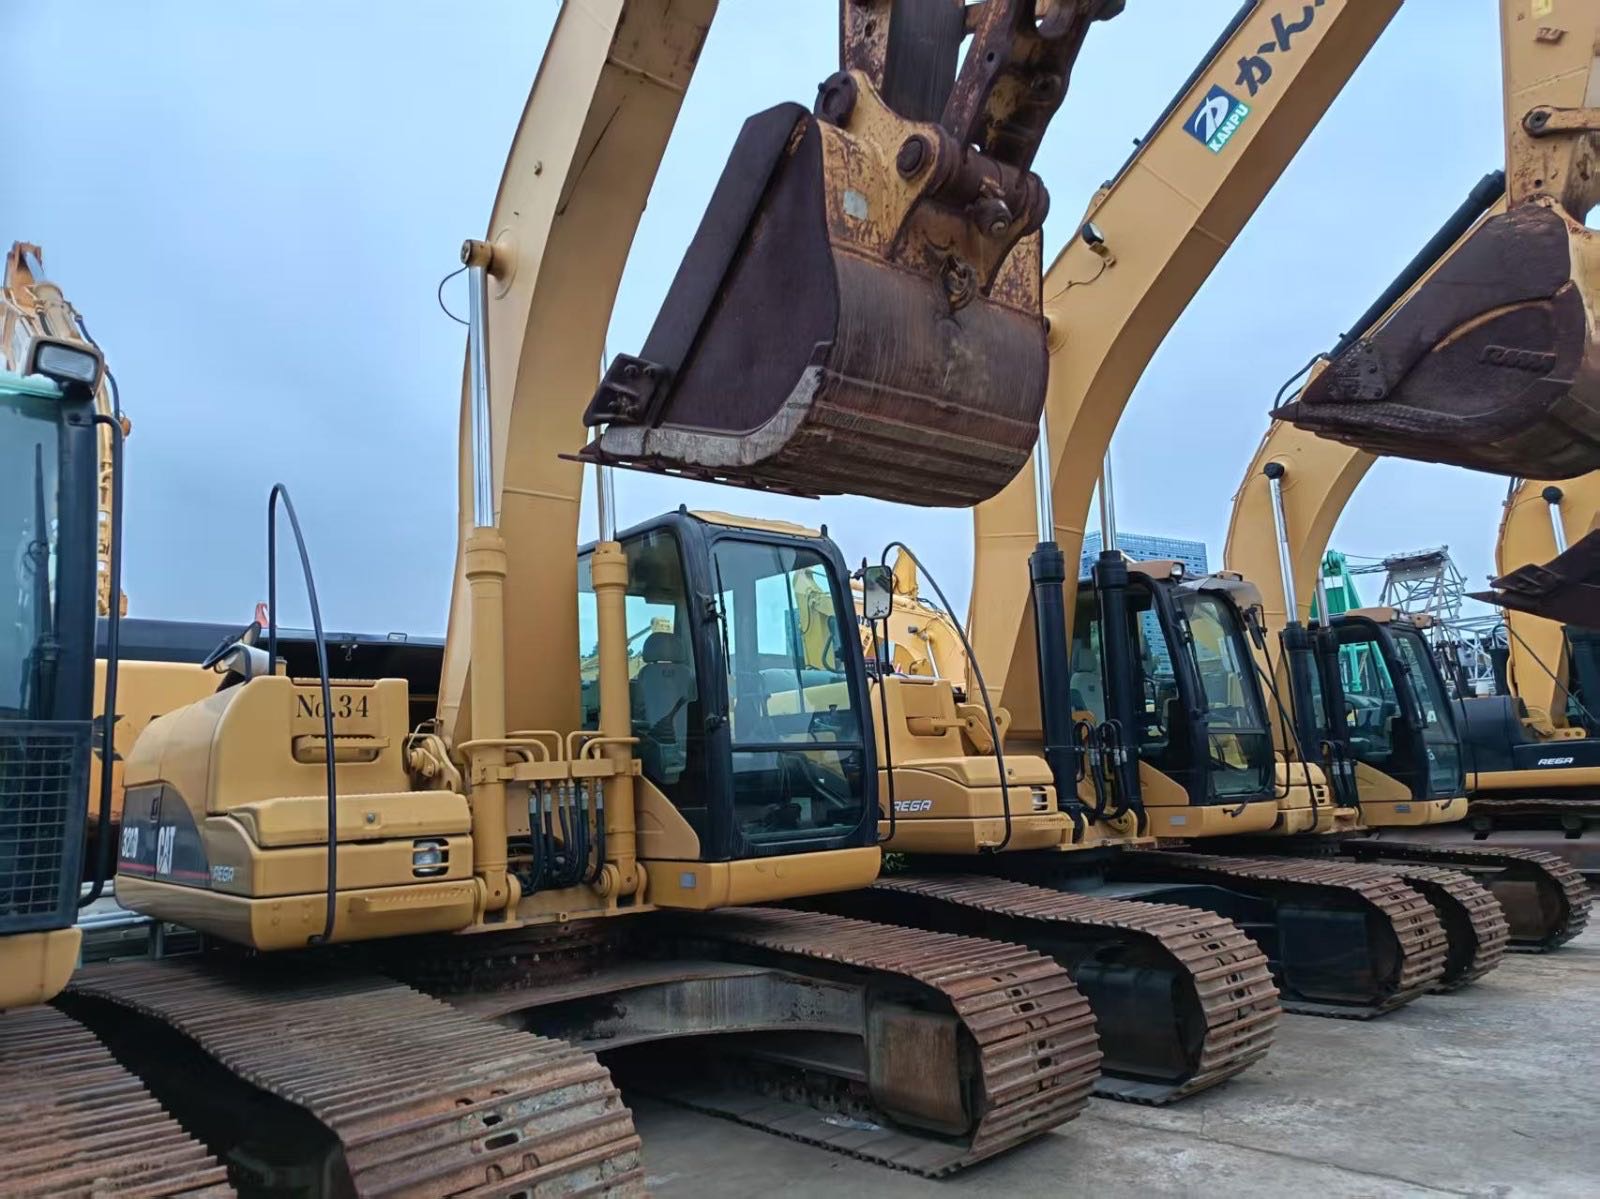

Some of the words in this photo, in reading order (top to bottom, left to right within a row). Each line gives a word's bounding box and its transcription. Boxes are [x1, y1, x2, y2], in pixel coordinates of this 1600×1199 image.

[1235, 0, 1325, 97] かん
[1208, 103, 1249, 153] KANPU
[157, 826, 176, 874] CAT
